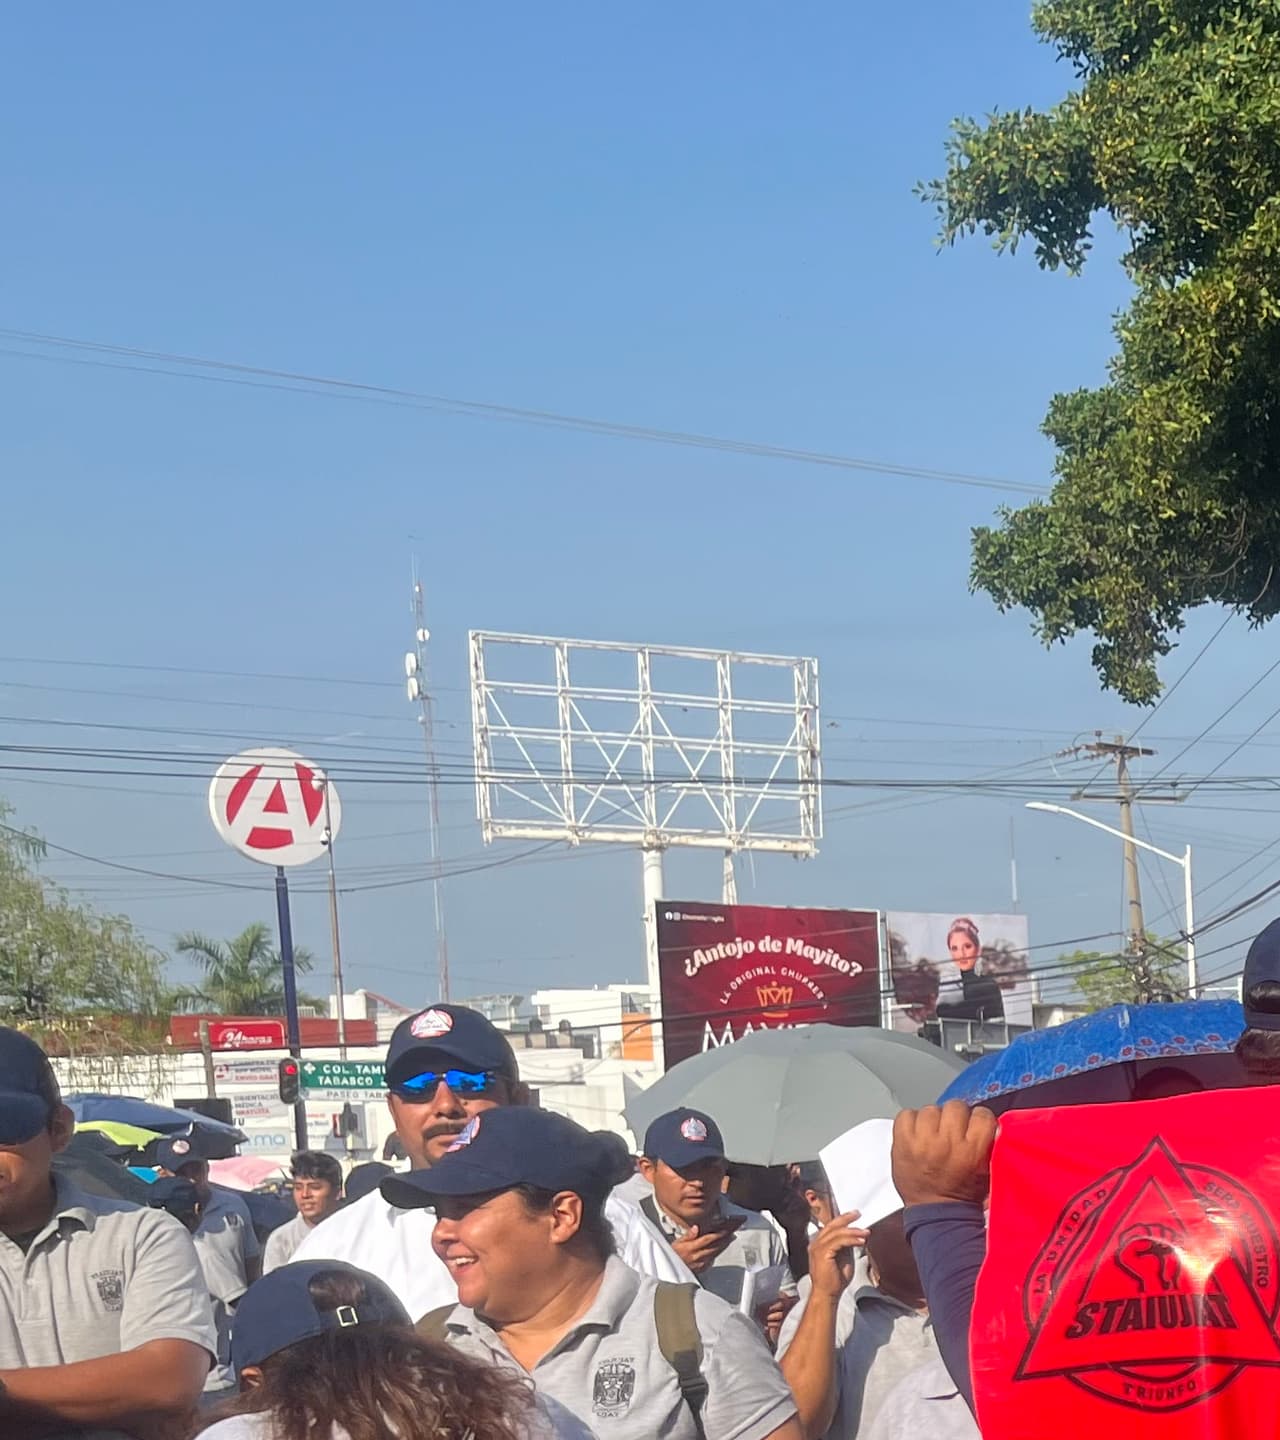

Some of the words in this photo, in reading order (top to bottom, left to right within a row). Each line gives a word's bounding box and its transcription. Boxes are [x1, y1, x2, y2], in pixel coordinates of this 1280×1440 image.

[685, 936, 756, 977] ¿Antojo
[758, 935, 783, 954] de
[785, 937, 864, 977] Mayito?
[730, 966, 777, 991] ORIGINAL
[318, 1076, 373, 1086] TABASCO
[1033, 1273, 1047, 1294] LA
[1046, 1188, 1107, 1262] UNIDAD
[1064, 1292, 1240, 1340] STAIUJAT
[1123, 1379, 1198, 1401] TRIUNFO
